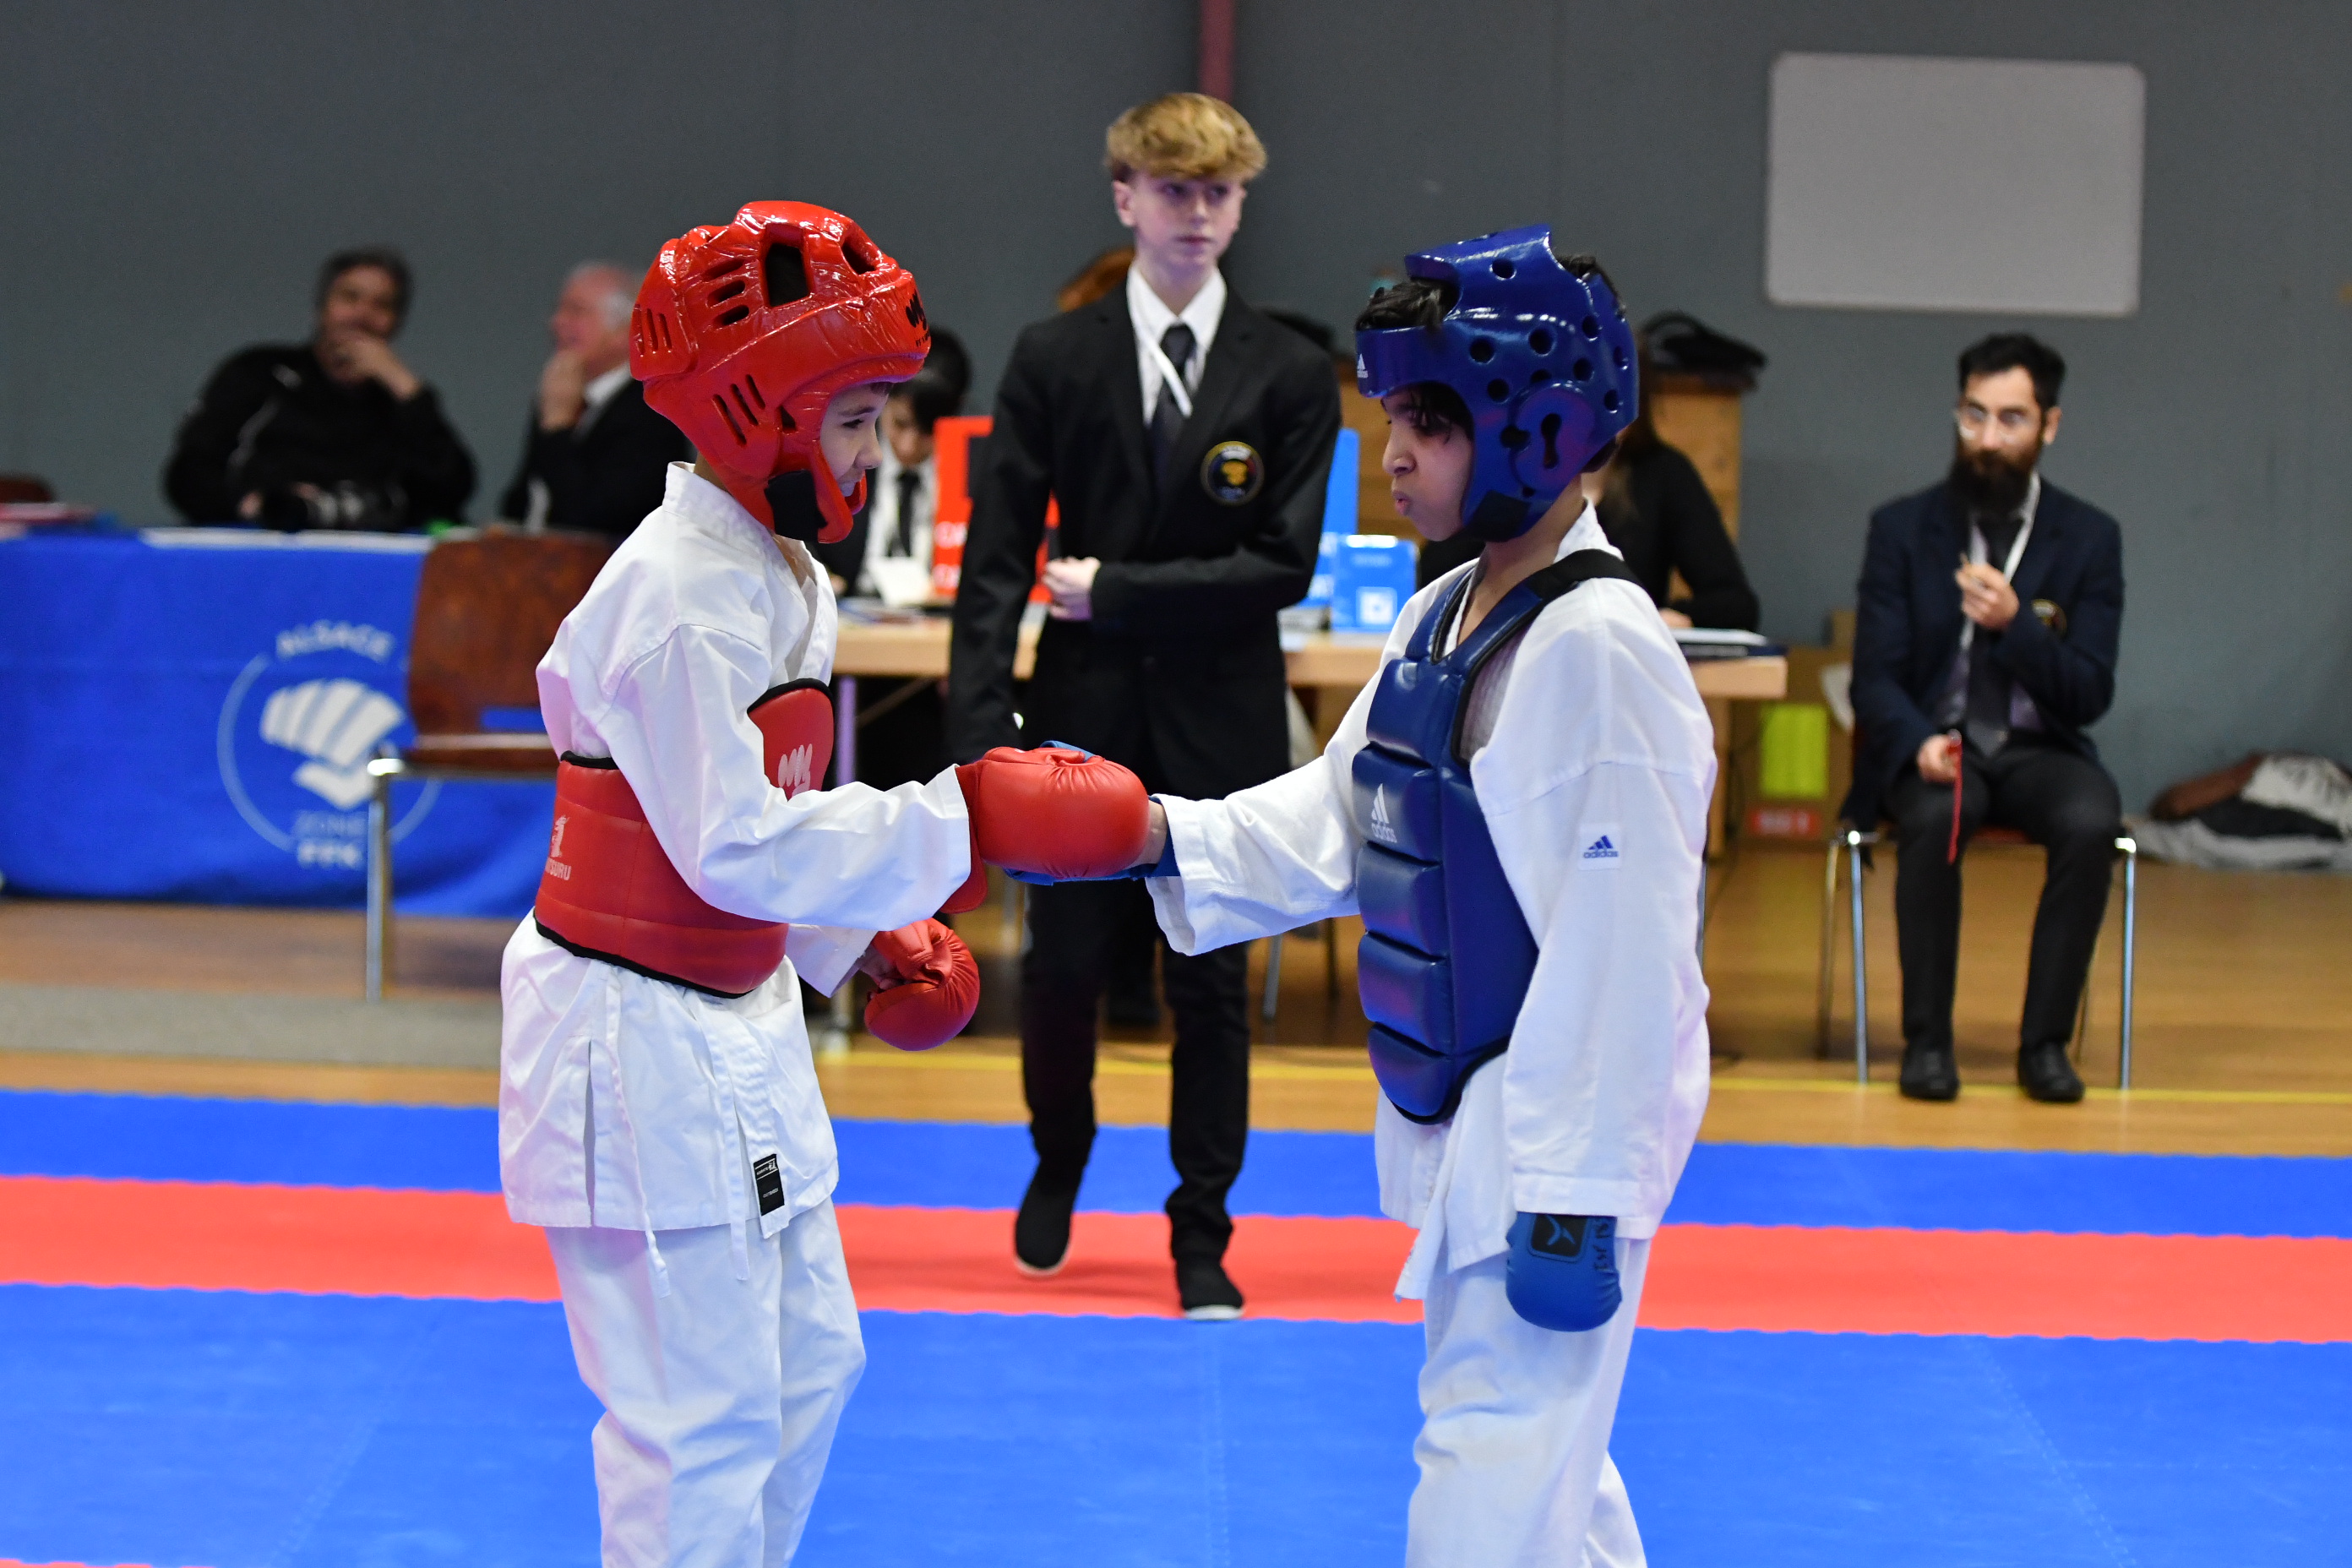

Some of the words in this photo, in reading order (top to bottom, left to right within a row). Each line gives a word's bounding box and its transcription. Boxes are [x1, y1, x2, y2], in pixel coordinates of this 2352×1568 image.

[276, 621, 395, 663] ALSACE
[1371, 819, 1398, 843] adidas
[1582, 848, 1619, 858] adidas
